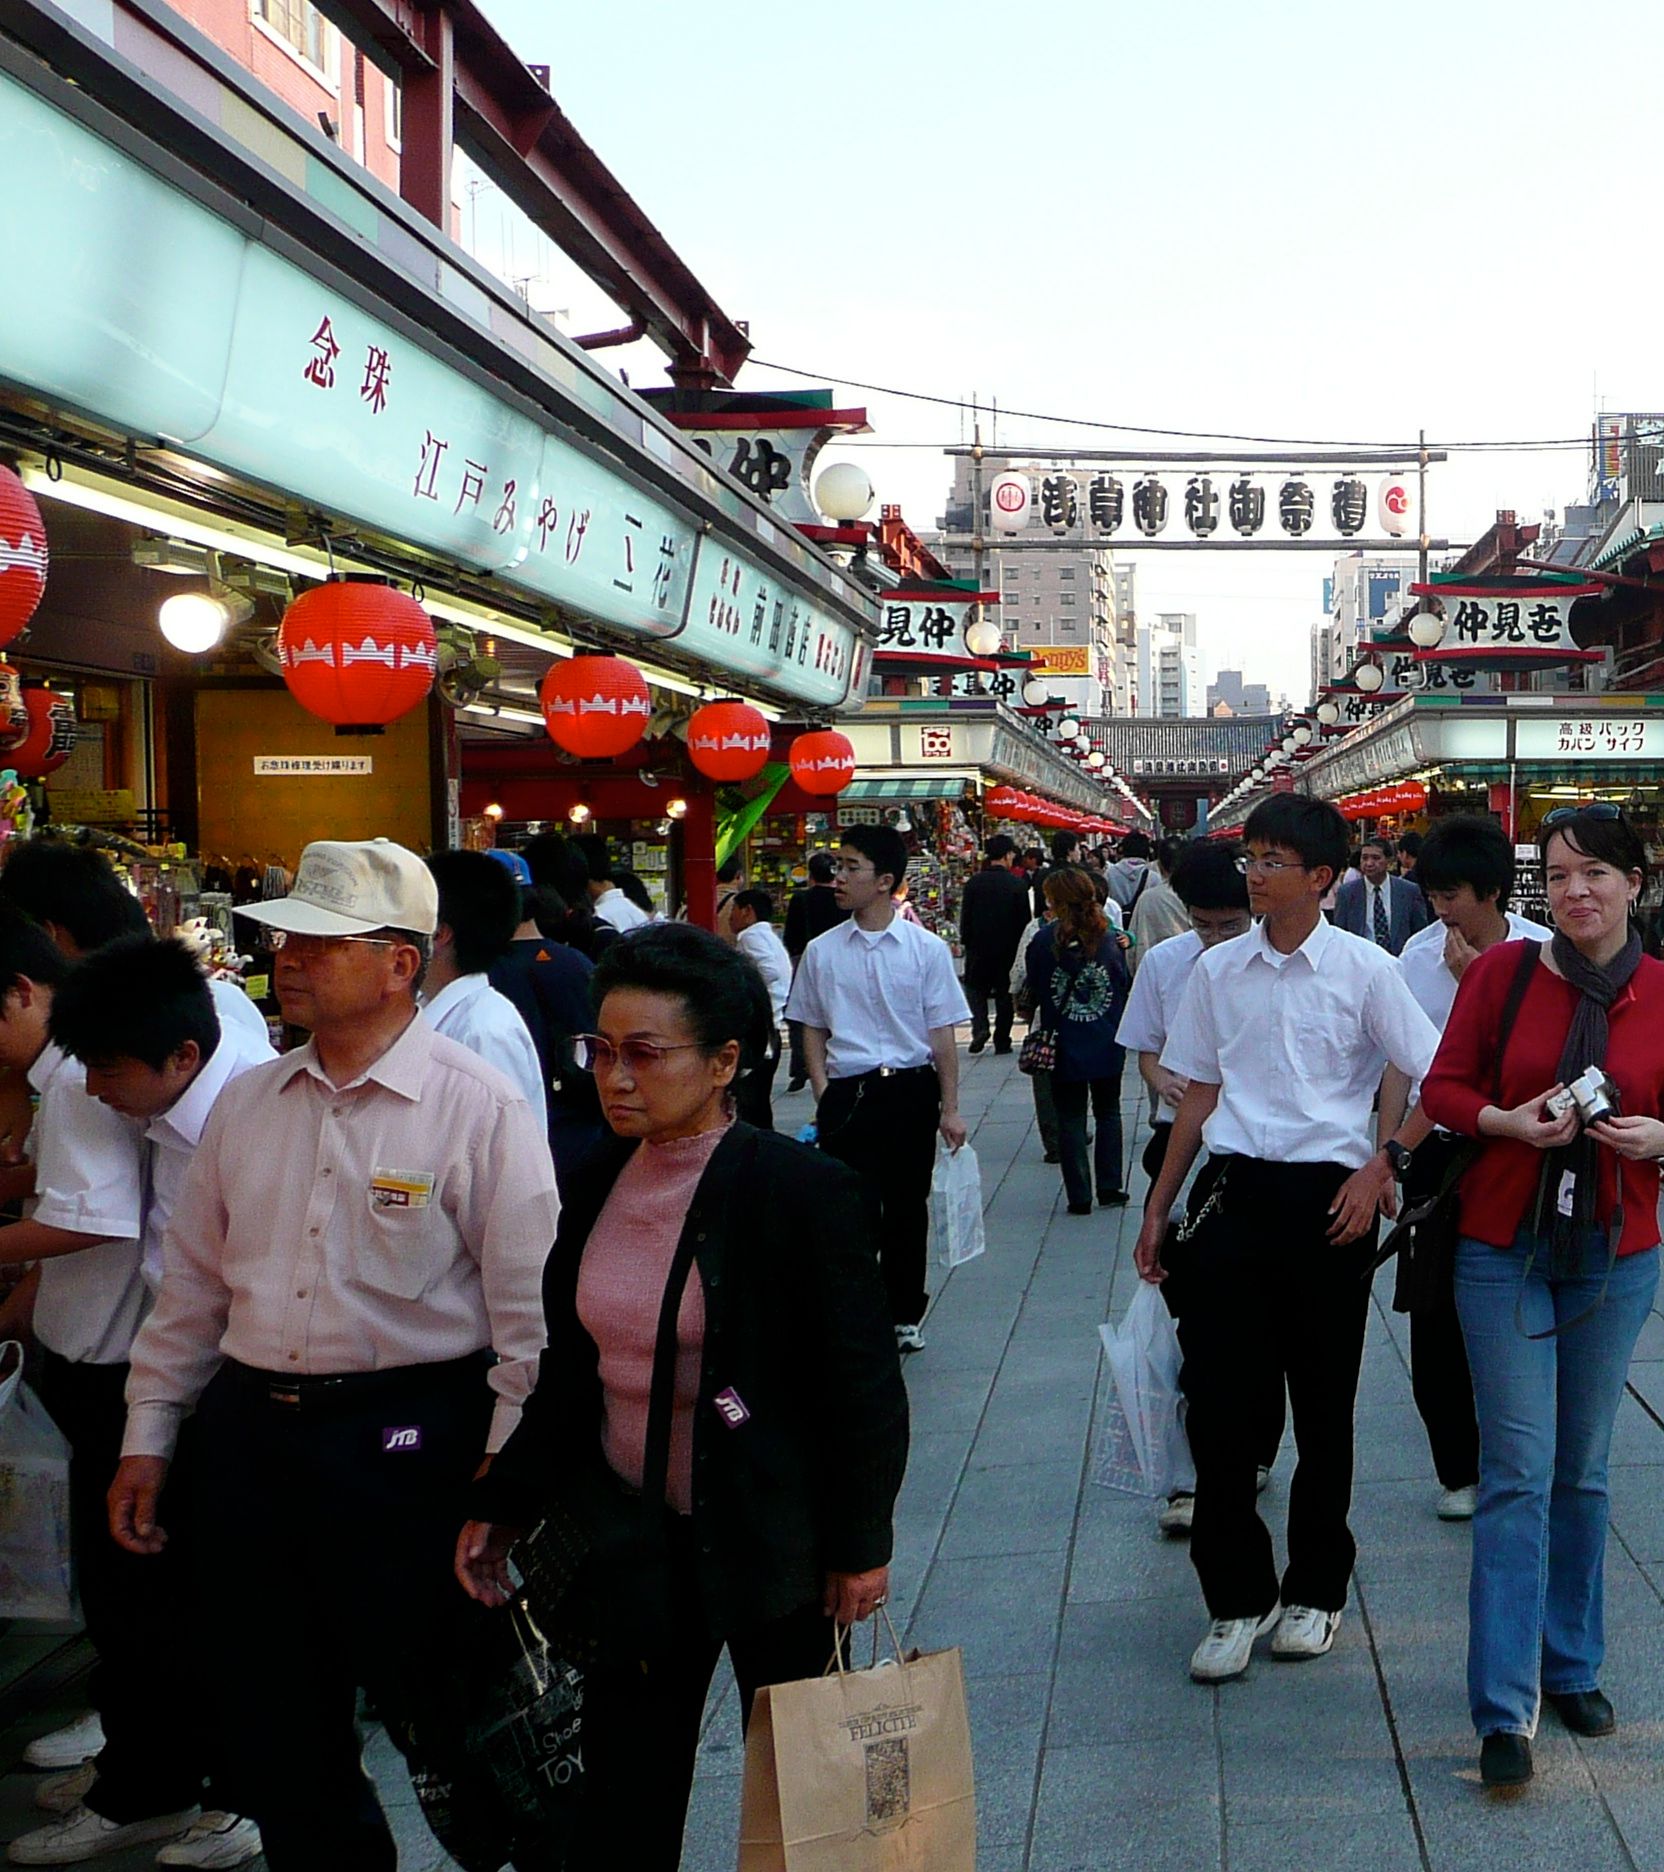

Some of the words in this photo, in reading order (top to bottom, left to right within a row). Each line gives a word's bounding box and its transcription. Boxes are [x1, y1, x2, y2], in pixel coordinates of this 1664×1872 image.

[303, 315, 392, 415] 念珠
[414, 429, 591, 566] 江戸みやげ
[1453, 601, 1563, 643] 仲見世
[1558, 738, 1596, 751] カバン
[1606, 738, 1644, 751] サイフ
[715, 1396, 743, 1422] JTB
[386, 1429, 419, 1450] JTB
